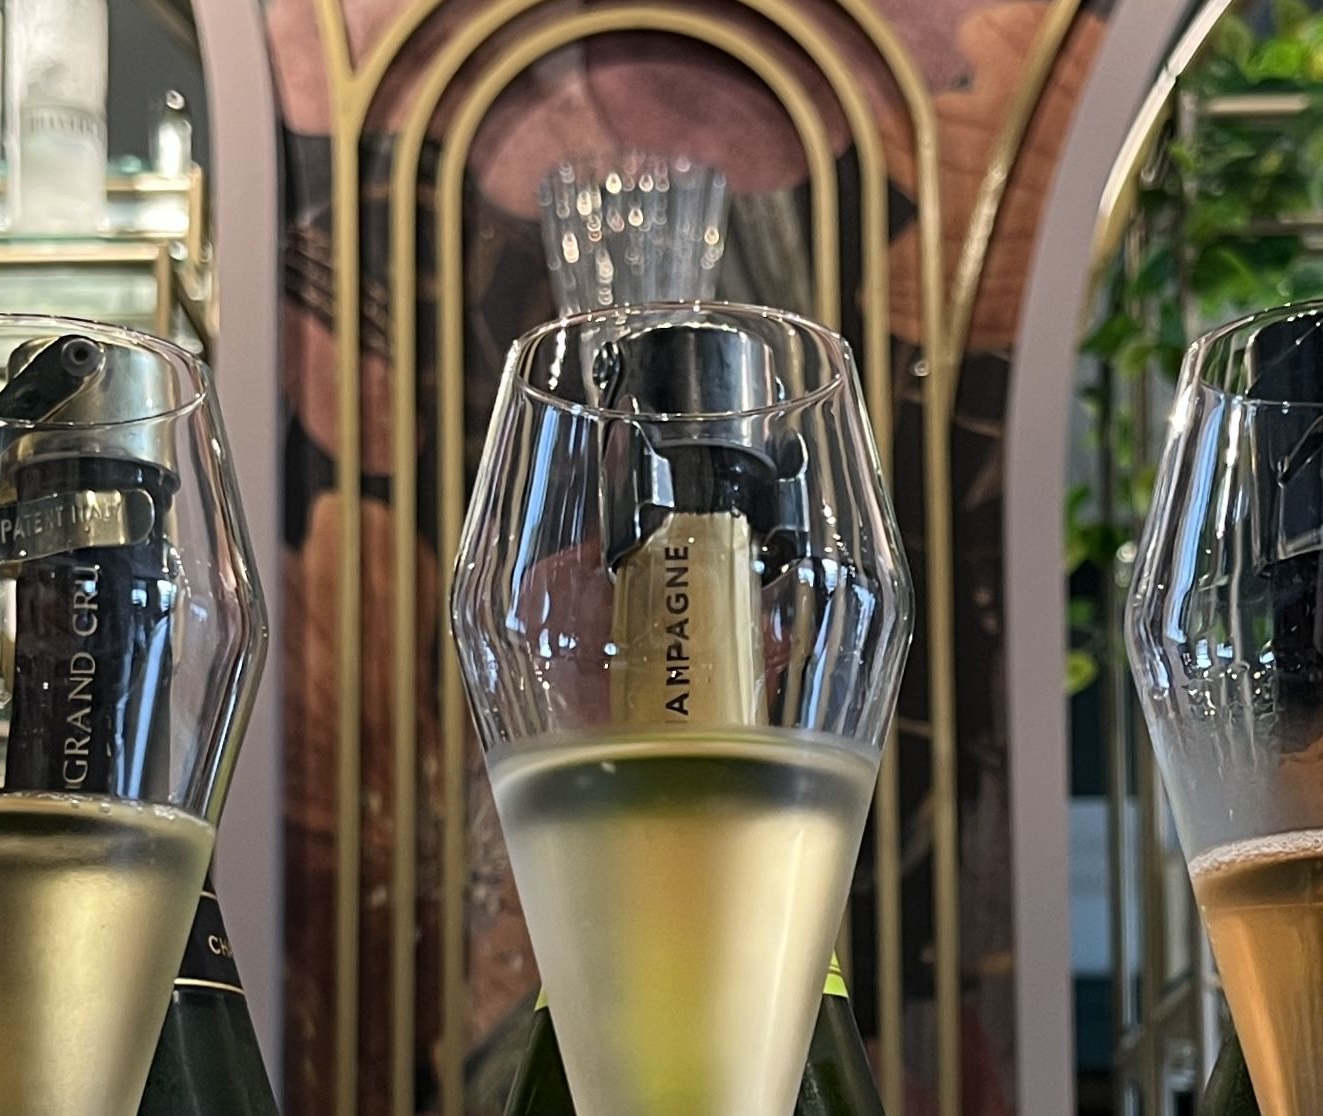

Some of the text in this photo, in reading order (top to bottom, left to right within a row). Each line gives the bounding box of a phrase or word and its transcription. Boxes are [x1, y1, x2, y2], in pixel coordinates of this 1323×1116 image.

[62, 565, 101, 787] GRAND CRU
[664, 546, 691, 724] AMPAGNE
